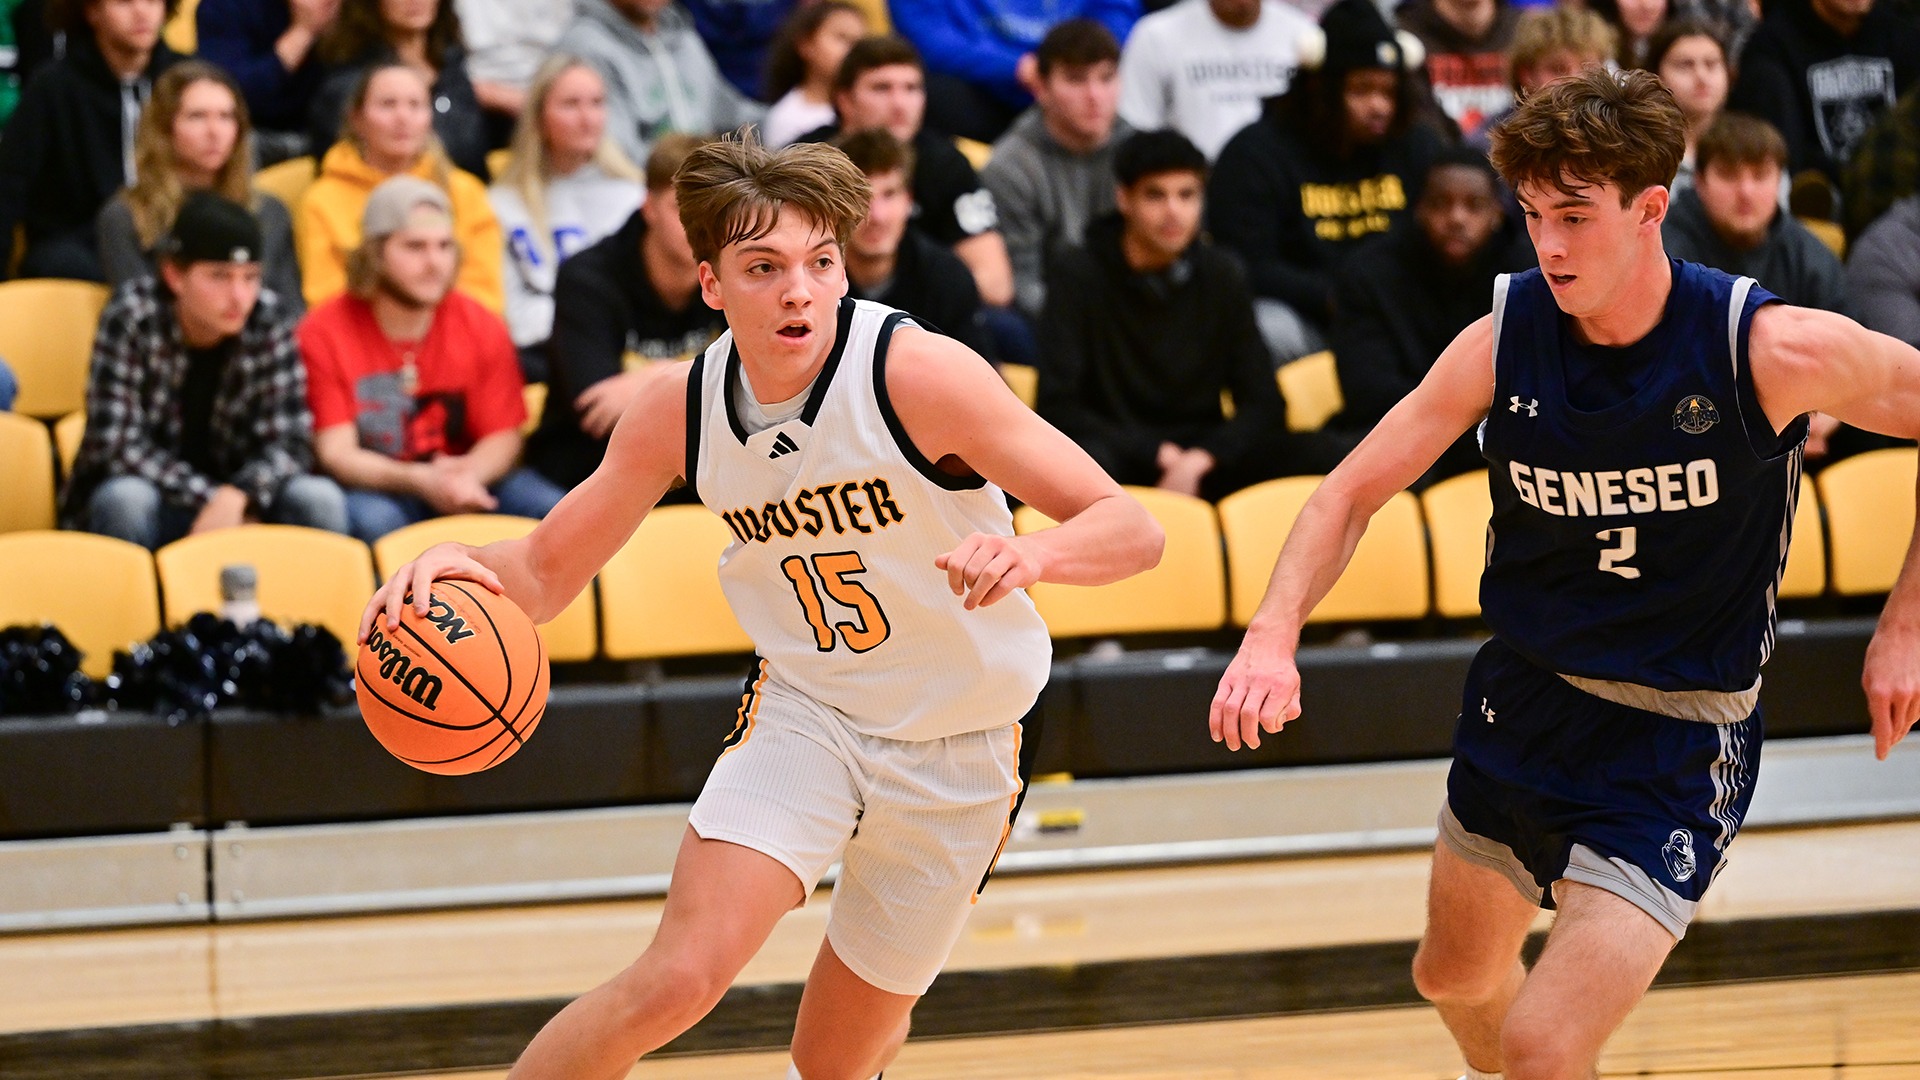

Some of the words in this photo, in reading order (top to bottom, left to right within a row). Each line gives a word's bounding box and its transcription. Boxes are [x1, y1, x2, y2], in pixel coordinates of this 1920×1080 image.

[721, 476, 907, 545] WOOSTER
[1508, 458, 1720, 518] GENESEO
[1595, 526, 1642, 580] 2
[402, 592, 476, 645] NC
[780, 550, 892, 655] 15
